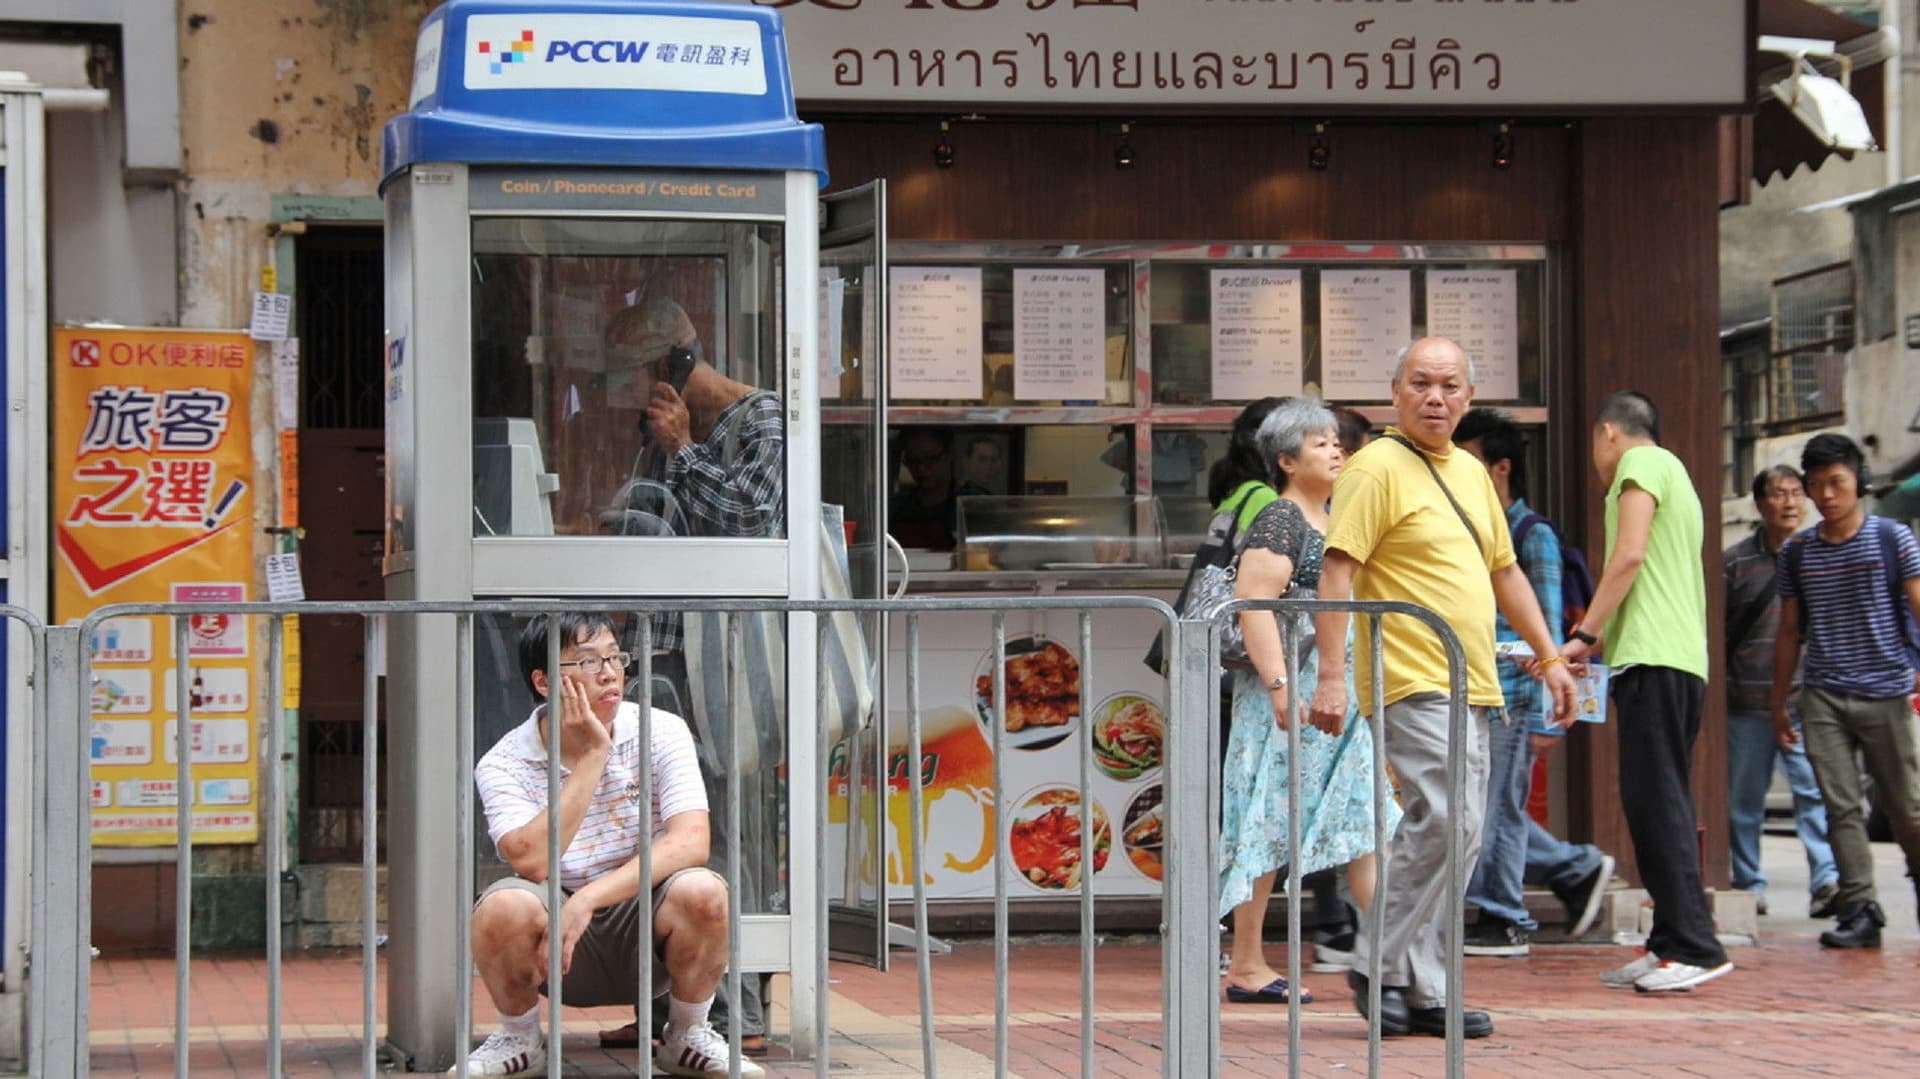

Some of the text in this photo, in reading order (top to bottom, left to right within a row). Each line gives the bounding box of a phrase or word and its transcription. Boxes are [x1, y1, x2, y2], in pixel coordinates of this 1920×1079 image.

[546, 41, 752, 66] PCCW 電訊盈科
[832, 19, 1504, 92] อาหารไทยและบาร์บีคิว
[717, 183, 757, 198] Card
[110, 341, 246, 370] OK便利店
[85, 387, 228, 450] 旅客
